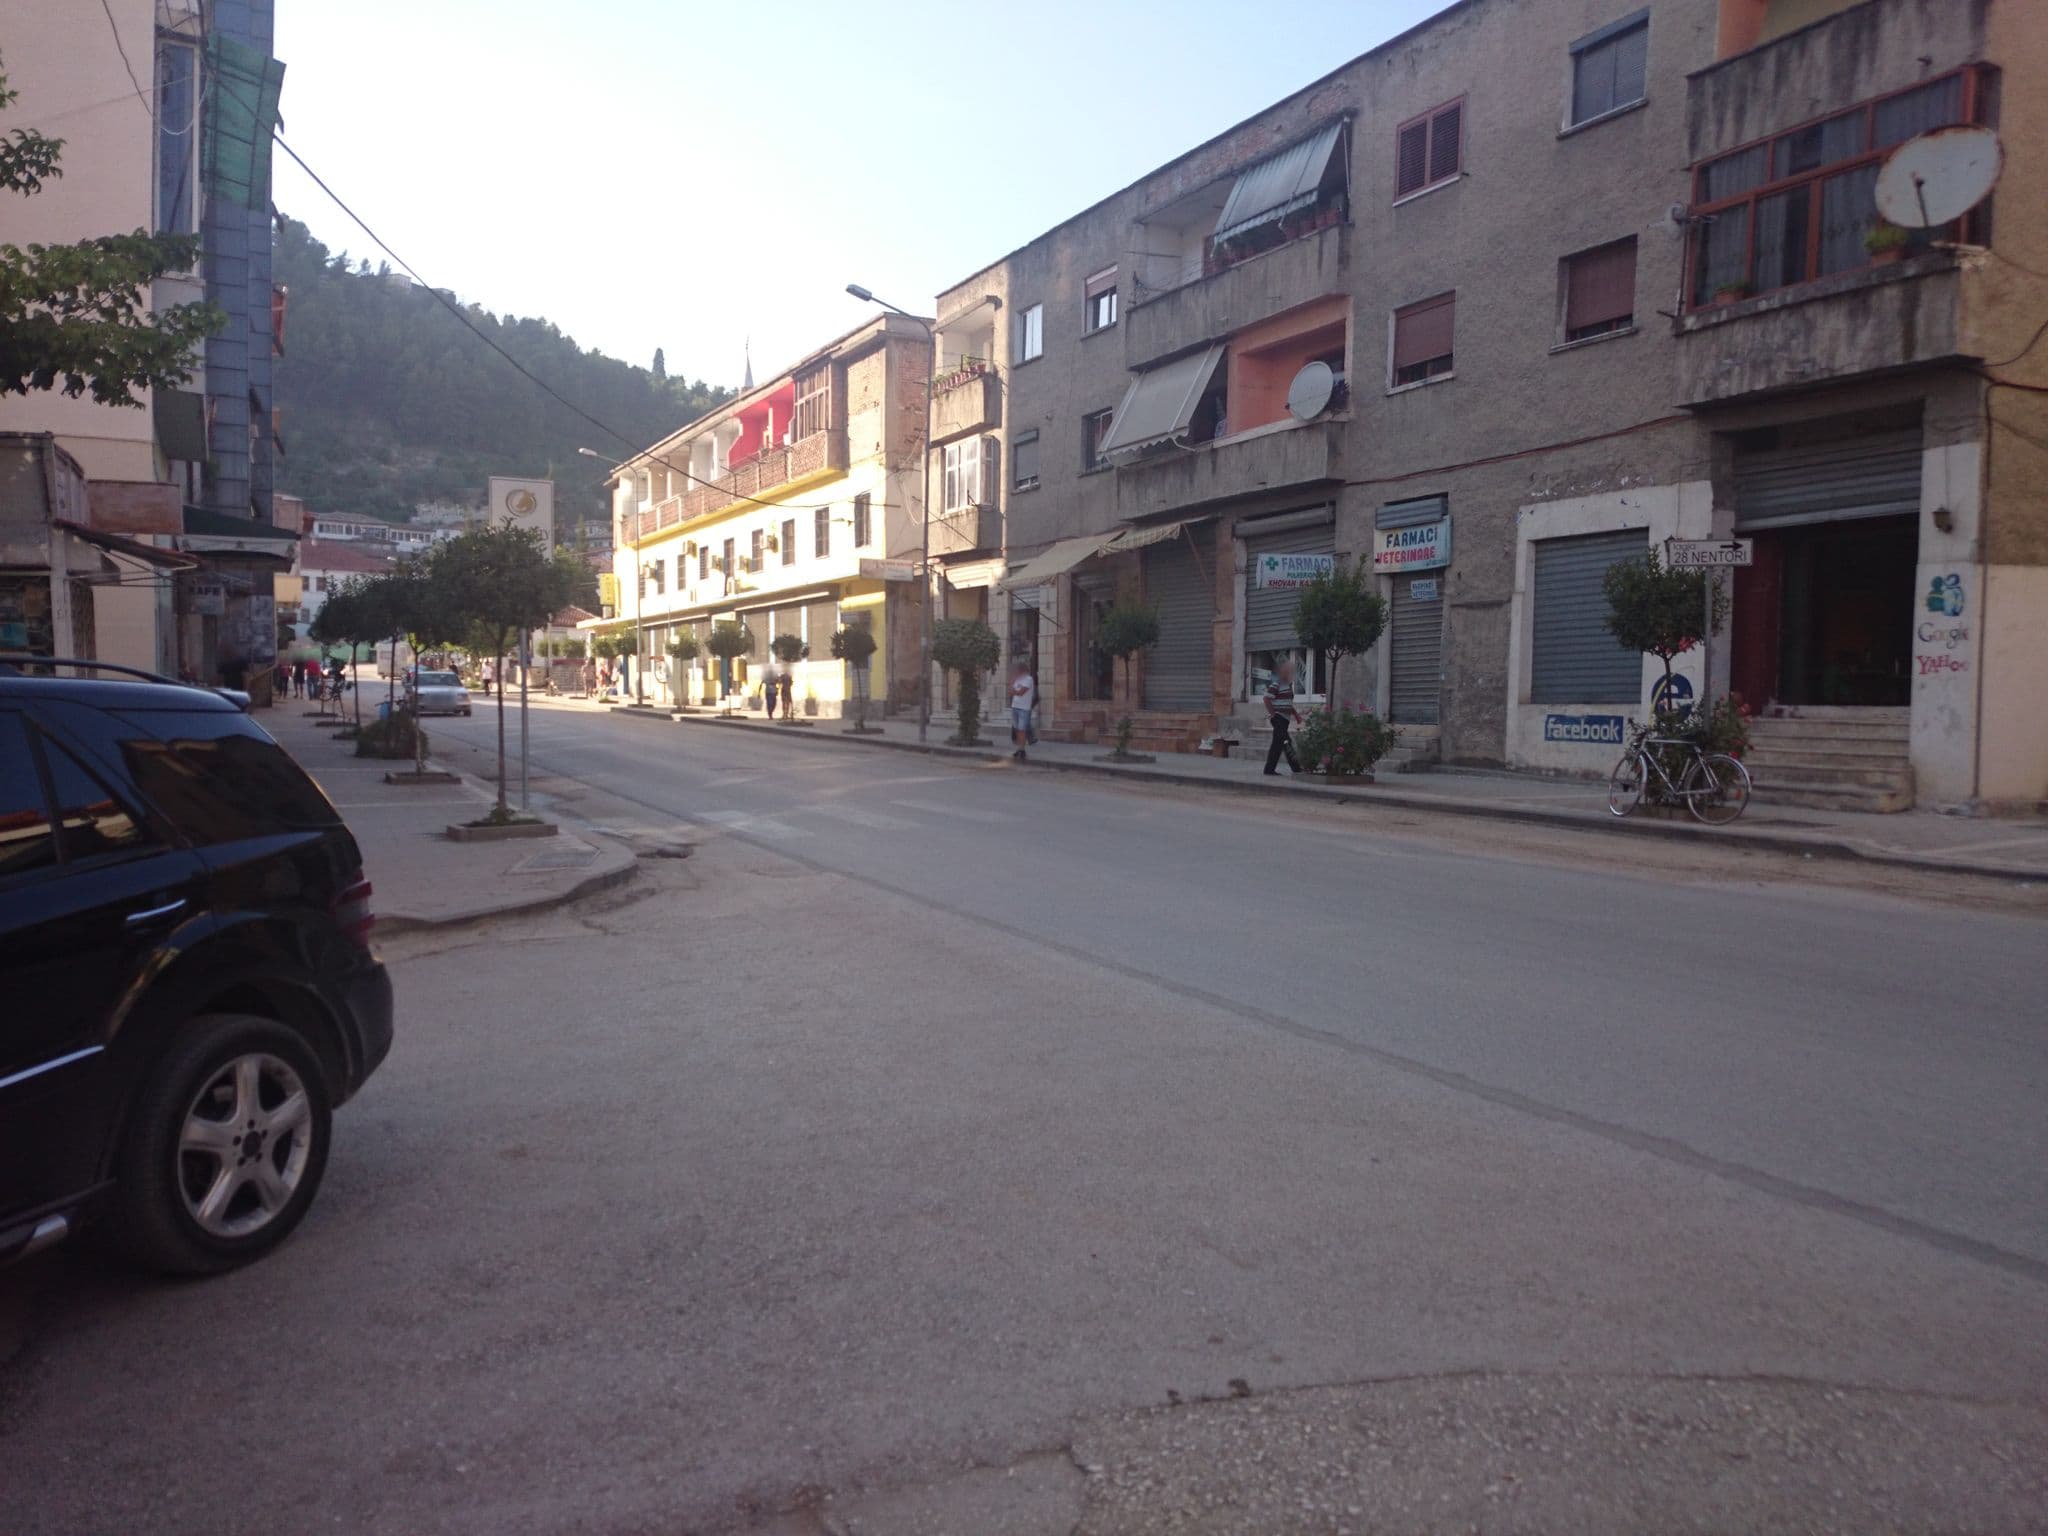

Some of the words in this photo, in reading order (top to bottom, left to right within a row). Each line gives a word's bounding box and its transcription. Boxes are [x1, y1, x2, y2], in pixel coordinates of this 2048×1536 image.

[1281, 557, 1332, 571] FARMACI
[1674, 552, 1688, 563] 28
[1691, 551, 1747, 563] NENTORI
[1547, 717, 1619, 741] facebook
